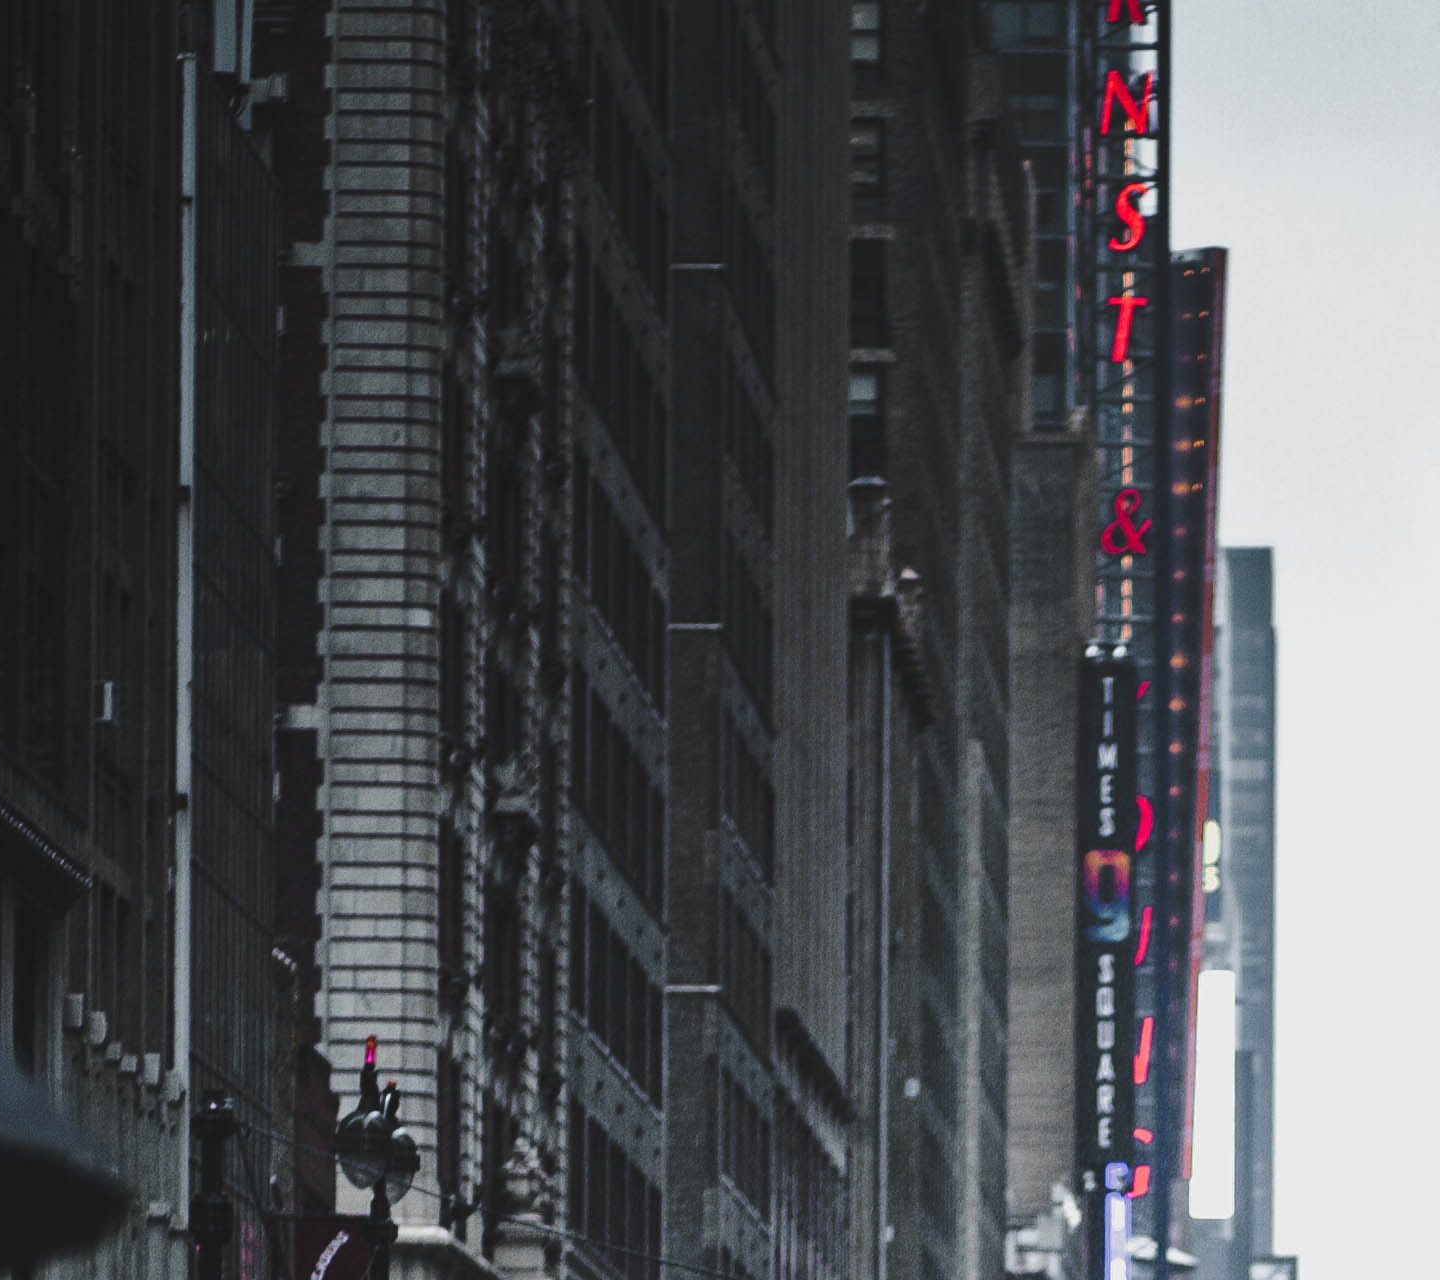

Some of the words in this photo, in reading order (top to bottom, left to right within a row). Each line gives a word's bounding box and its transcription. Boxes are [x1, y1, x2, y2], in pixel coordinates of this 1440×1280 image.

[1101, 0, 1154, 362] NST
[1097, 676, 1118, 838] TIMES
[1095, 954, 1116, 1148] SQUARE
